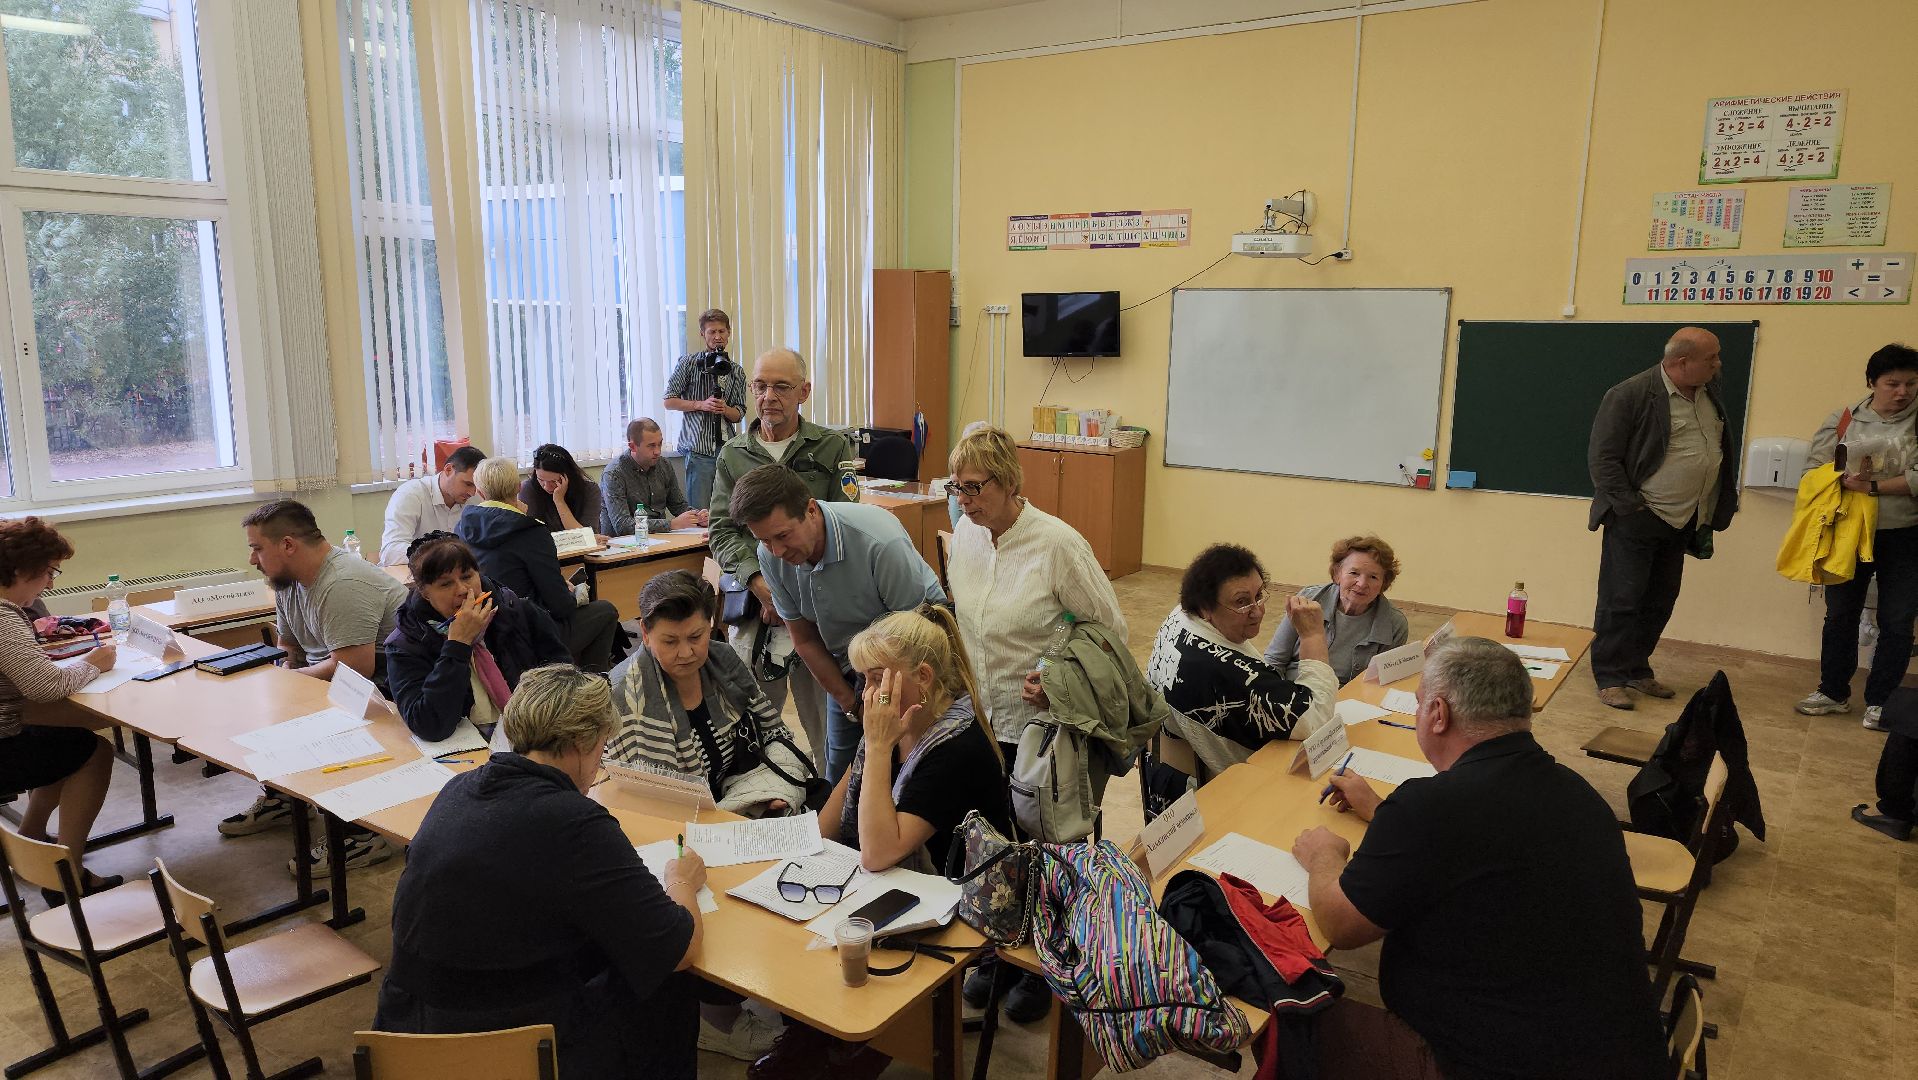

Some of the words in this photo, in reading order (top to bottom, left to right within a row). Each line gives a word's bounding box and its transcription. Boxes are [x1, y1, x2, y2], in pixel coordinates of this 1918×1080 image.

[1713, 96, 1793, 107] АРИФМЕТИЧЕСКИЕ
[1794, 92, 1841, 103] ДЕЙСТВИЯ
[1723, 108, 1764, 117] СЛОЖЕНИЕ
[1718, 122, 1725, 132] 2
[1738, 121, 1745, 132] 2
[1757, 119, 1765, 130] 4
[1786, 118, 1794, 128] 4
[1803, 116, 1811, 128] 2
[1823, 116, 1831, 127] 2
[1716, 143, 1762, 151] УМНОЖЕНИЕ
[1786, 139, 1822, 148] ДЕЛЕНИЕ
[1713, 157, 1721, 167] 2
[1733, 155, 1741, 166] 2
[1753, 154, 1760, 164] 4
[1779, 153, 1787, 164] 4
[1796, 152, 1804, 164] 2
[1817, 151, 1825, 163] 2
[1632, 272, 1642, 285] 0
[1655, 272, 1661, 285] 1
[1671, 271, 1680, 284] 2
[1690, 271, 1698, 284] 3
[1707, 270, 1716, 284] 4
[1726, 270, 1735, 284] 5
[1745, 270, 1755, 284] 6
[1766, 269, 1775, 284] 7
[1784, 269, 1793, 284] 8
[1804, 269, 1814, 283] 9
[1817, 269, 1834, 283] 10
[1647, 288, 1660, 301] 11
[1664, 287, 1679, 301] 12
[1683, 287, 1697, 300] 13
[1701, 287, 1715, 301] 14
[1718, 286, 1734, 300] 15
[1738, 286, 1754, 301] 16
[1757, 286, 1773, 300] 17
[1776, 286, 1792, 300] 18
[1796, 286, 1812, 300] 19
[1814, 286, 1832, 300] 20
